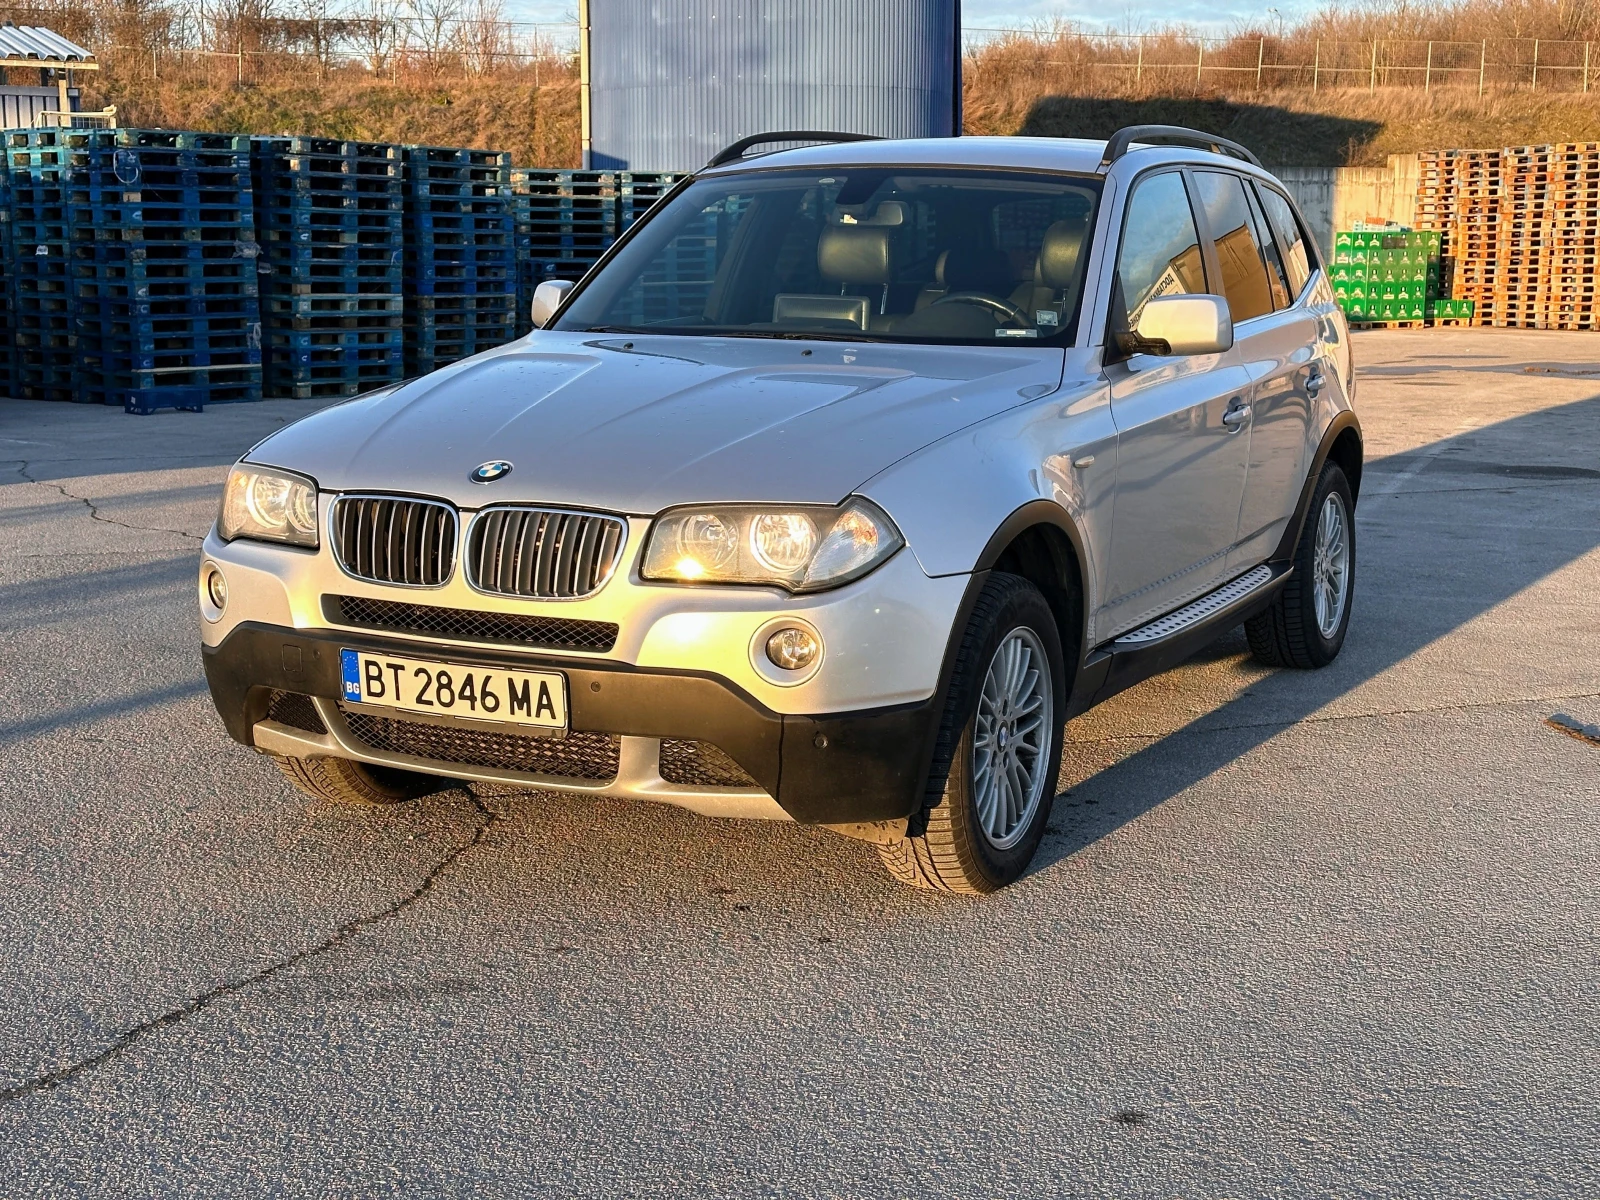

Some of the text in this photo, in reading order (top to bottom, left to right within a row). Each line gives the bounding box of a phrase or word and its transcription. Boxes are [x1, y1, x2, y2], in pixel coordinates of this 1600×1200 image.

[346, 681, 360, 694] BG
[364, 659, 557, 720] BT 2846 MA
